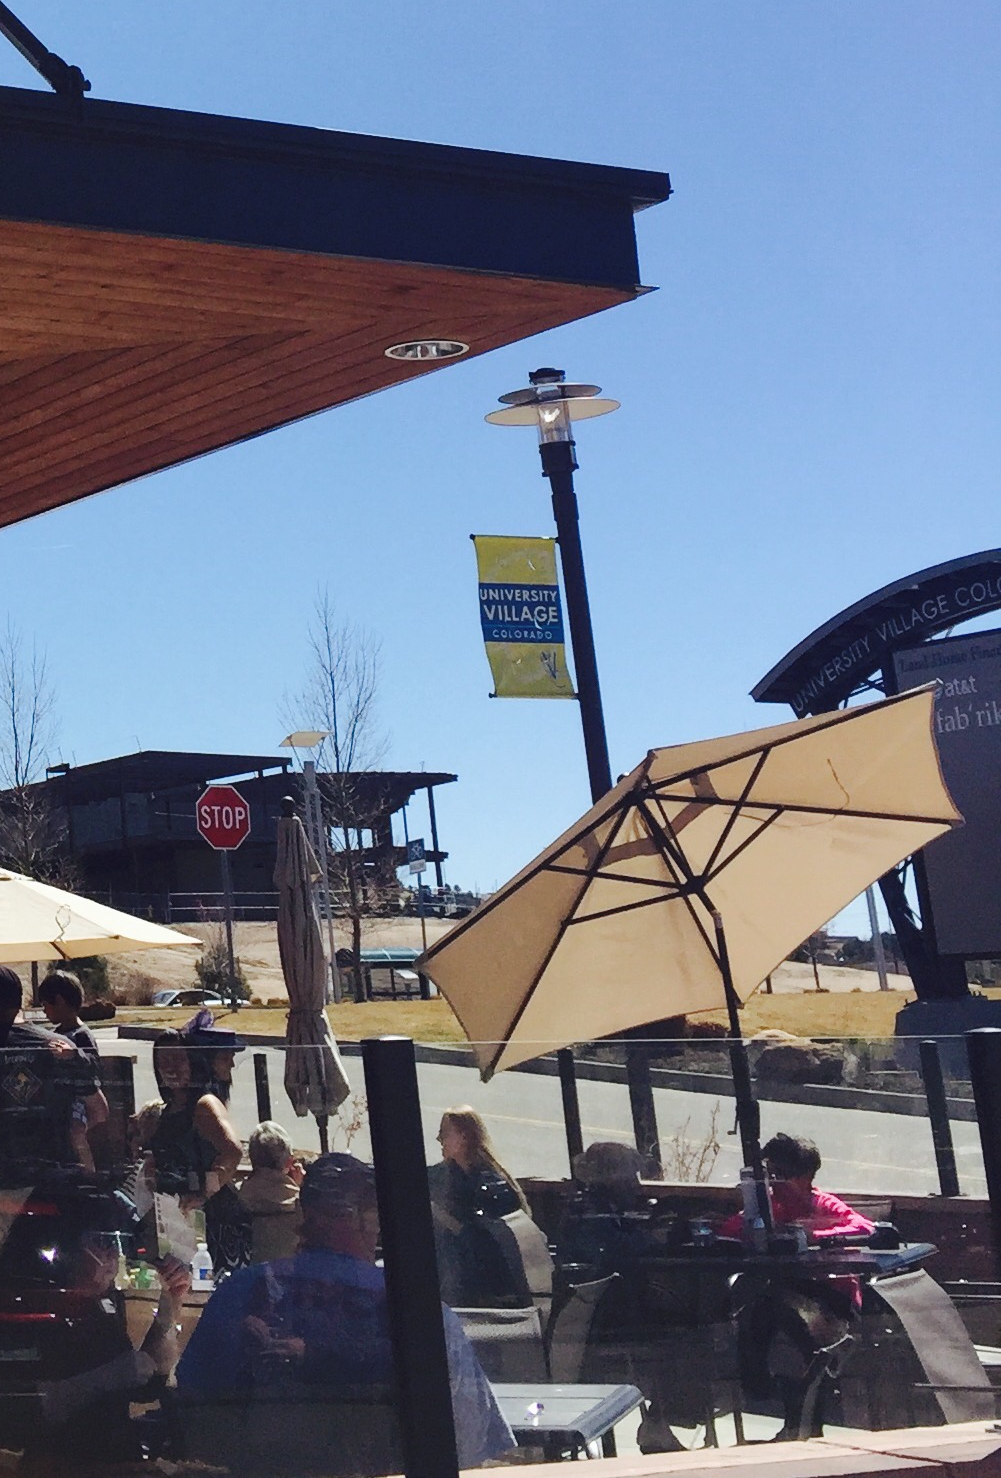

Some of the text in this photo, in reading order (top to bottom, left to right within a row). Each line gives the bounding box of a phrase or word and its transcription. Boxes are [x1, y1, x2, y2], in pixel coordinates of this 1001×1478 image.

[479, 588, 558, 603] UNIVERSITY
[483, 604, 559, 624] VILLAGE
[492, 628, 553, 640] COLORADO
[791, 634, 871, 712] UNIVERSITY
[876, 594, 950, 642] VILLAGE
[944, 675, 978, 697] at&t
[200, 805, 246, 830] STOP
